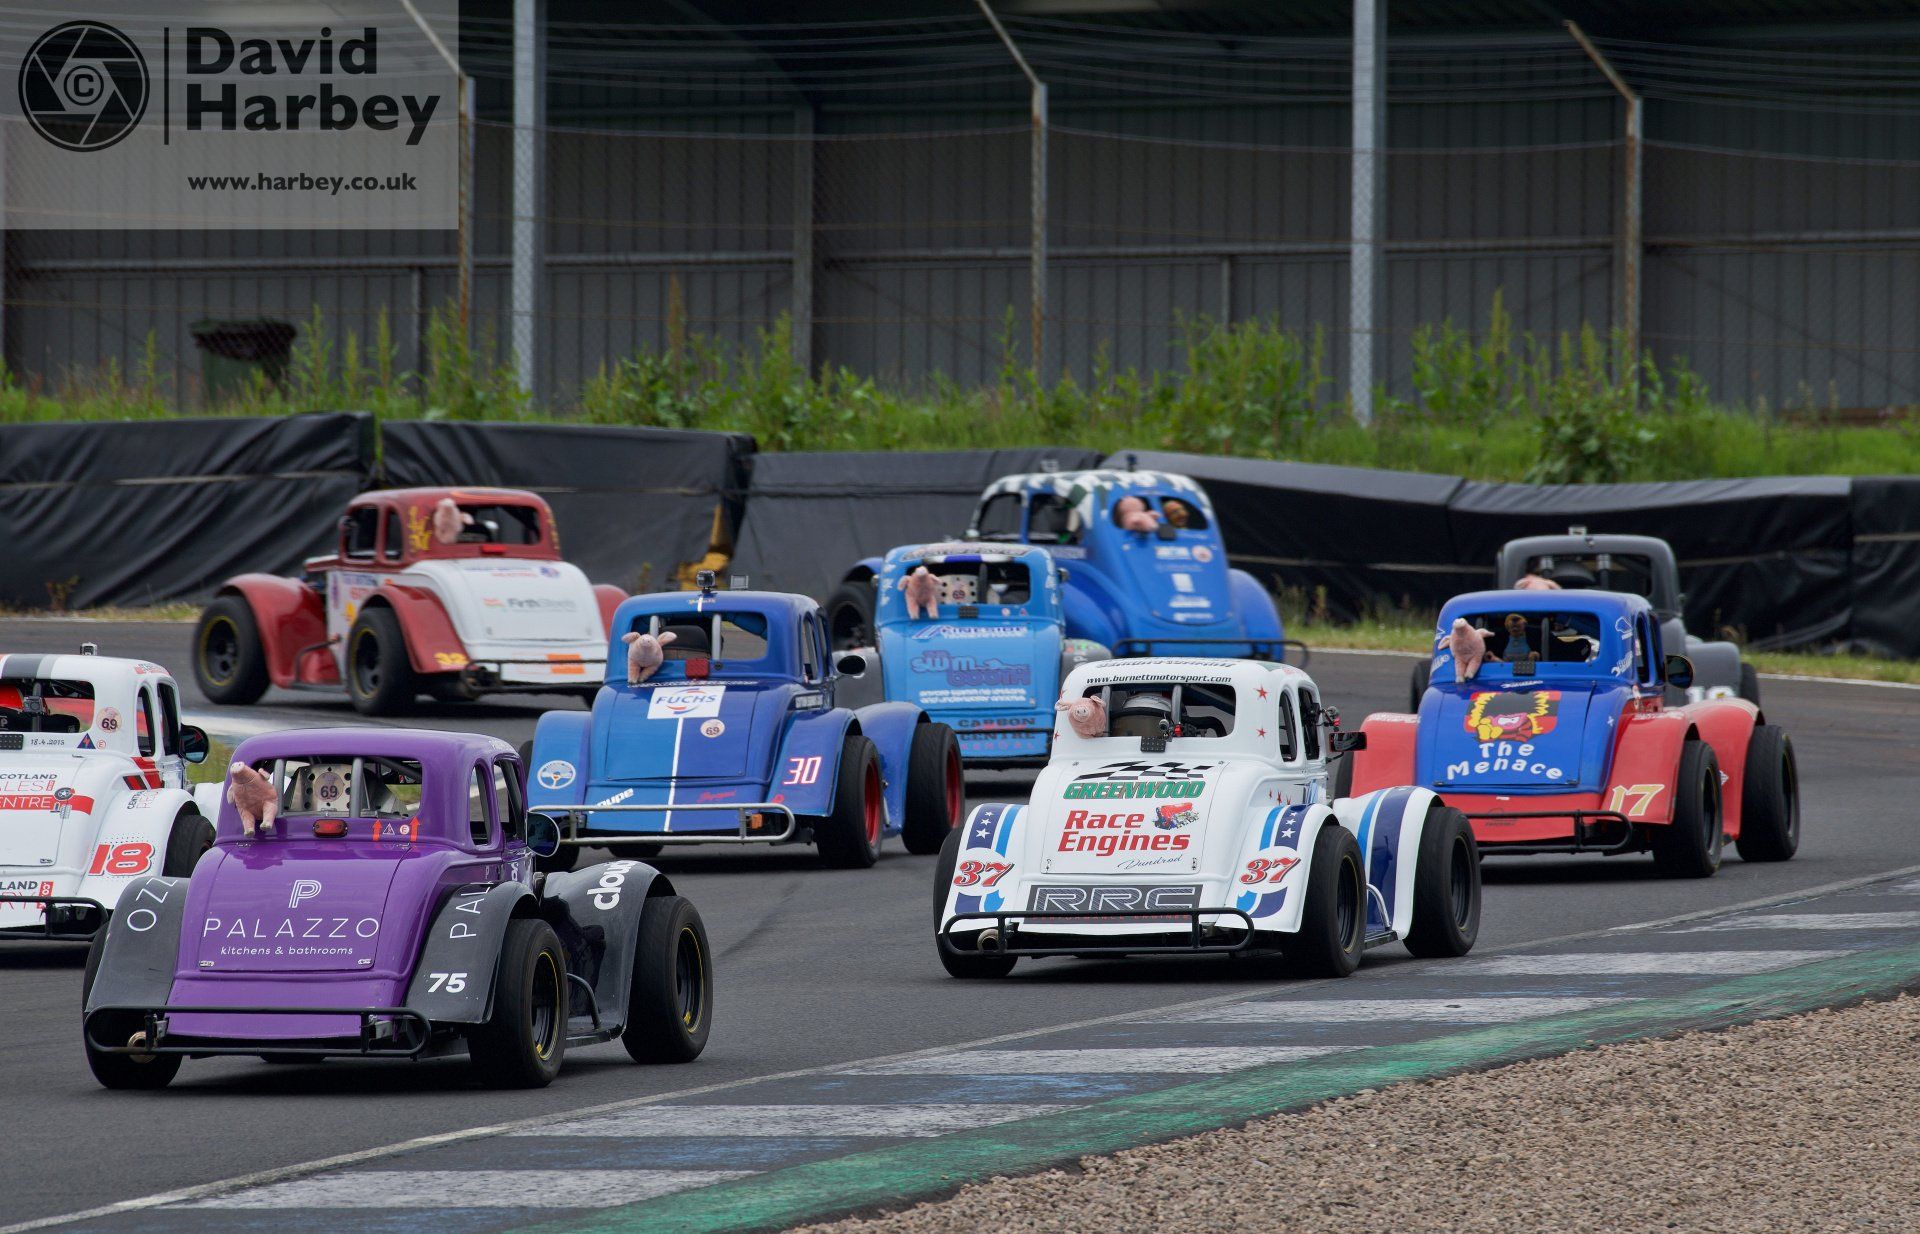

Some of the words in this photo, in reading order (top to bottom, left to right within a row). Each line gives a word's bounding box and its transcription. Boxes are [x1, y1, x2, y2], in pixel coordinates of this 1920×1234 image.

[1086, 674, 1232, 684] www.burnettmotorsport.com
[655, 693, 717, 705] FUCHS
[101, 718, 118, 730] 69
[1478, 740, 1535, 758] The
[783, 756, 822, 785] 30
[1446, 757, 1563, 781] Menace
[320, 785, 338, 798] 69
[1062, 780, 1206, 800] GREENWOOD
[1608, 784, 1666, 816] 17
[1064, 810, 1145, 830] Race
[1057, 829, 1191, 857] Engines
[88, 841, 155, 876] 18
[953, 860, 1015, 887] 37
[1239, 857, 1301, 884] 37
[1033, 887, 1196, 912] RRC
[203, 918, 379, 938] PALAZZO
[220, 946, 271, 955] kitchens
[274, 947, 284, 955] &
[288, 946, 353, 955] bathrooms
[427, 973, 468, 993] 75
